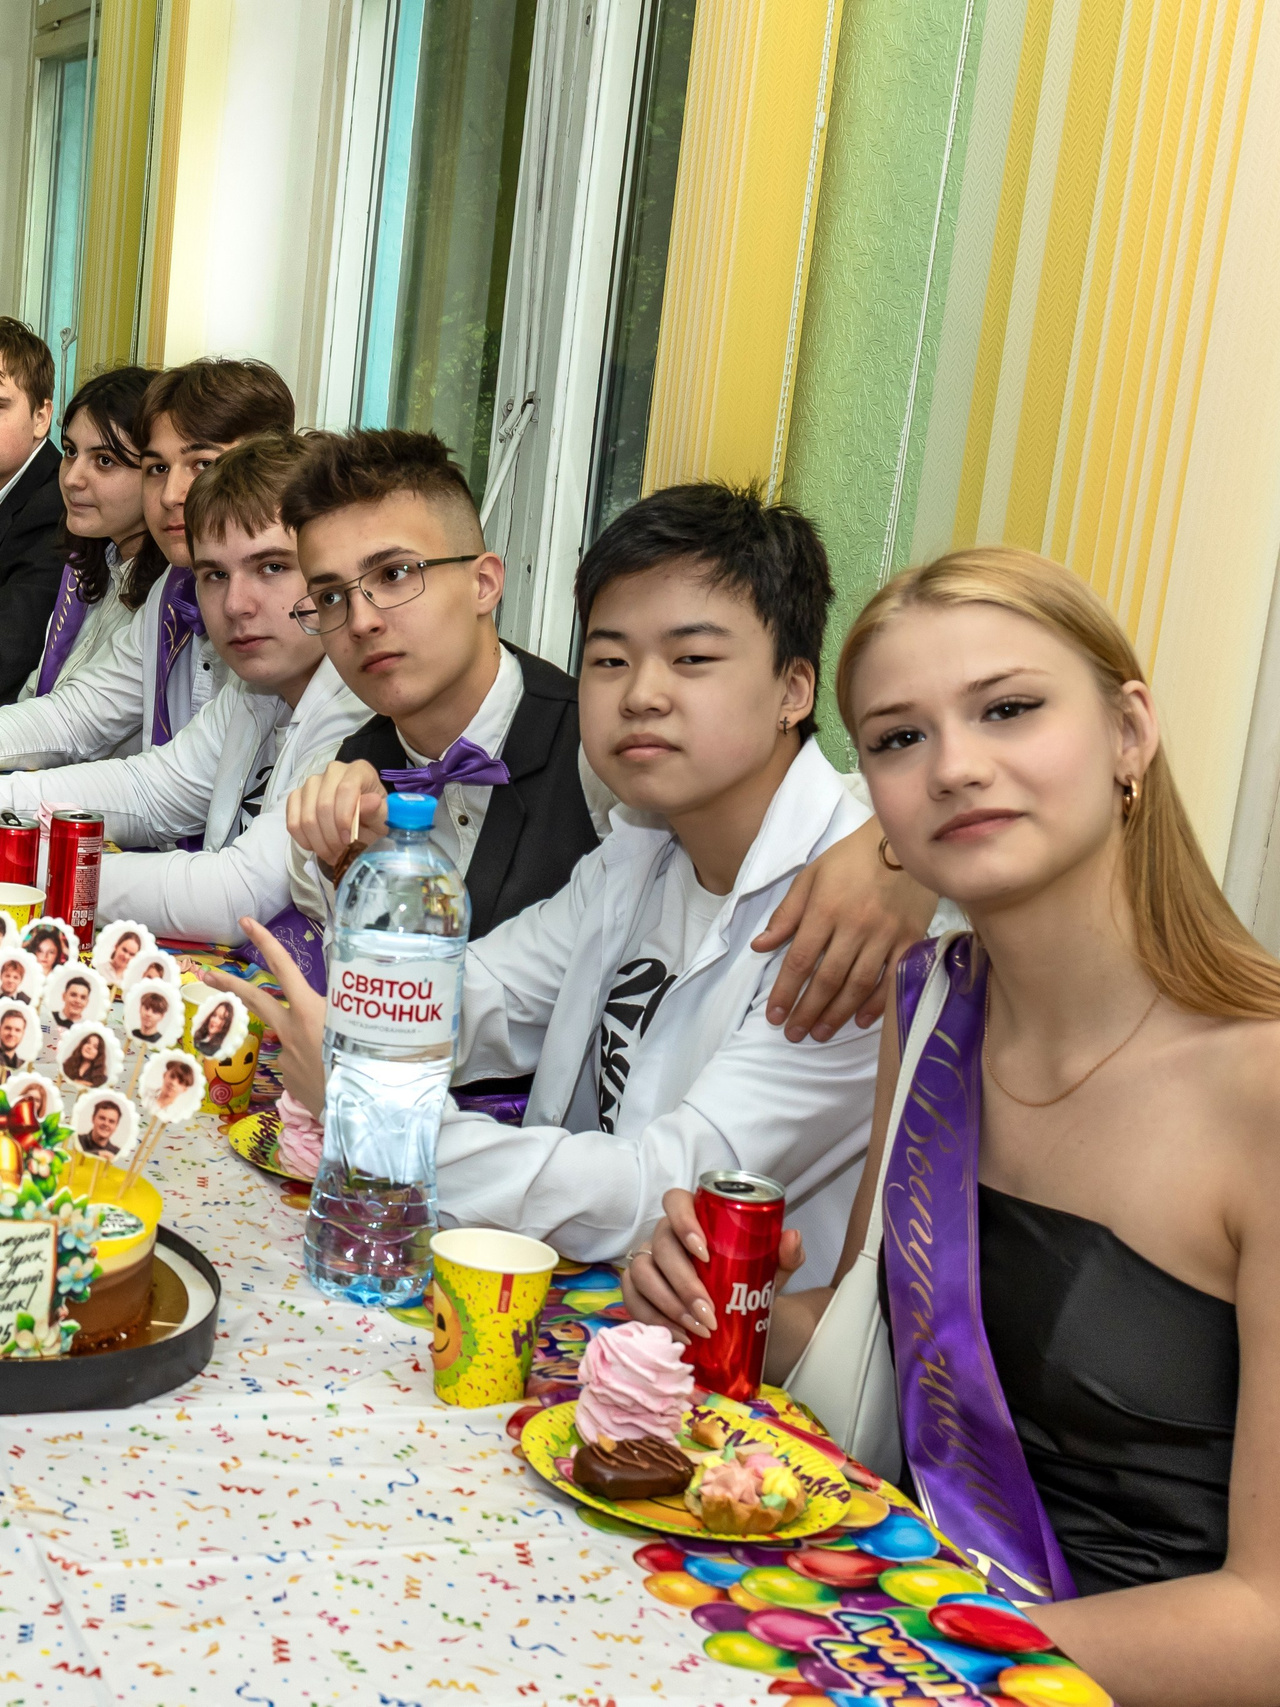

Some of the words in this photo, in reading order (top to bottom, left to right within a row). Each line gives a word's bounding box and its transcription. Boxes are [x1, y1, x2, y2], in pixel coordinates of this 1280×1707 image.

[342, 970, 433, 1000] СВЯТОЙ
[331, 987, 444, 1023] ИСТОЧНИК
[725, 1280, 774, 1316] Доб
